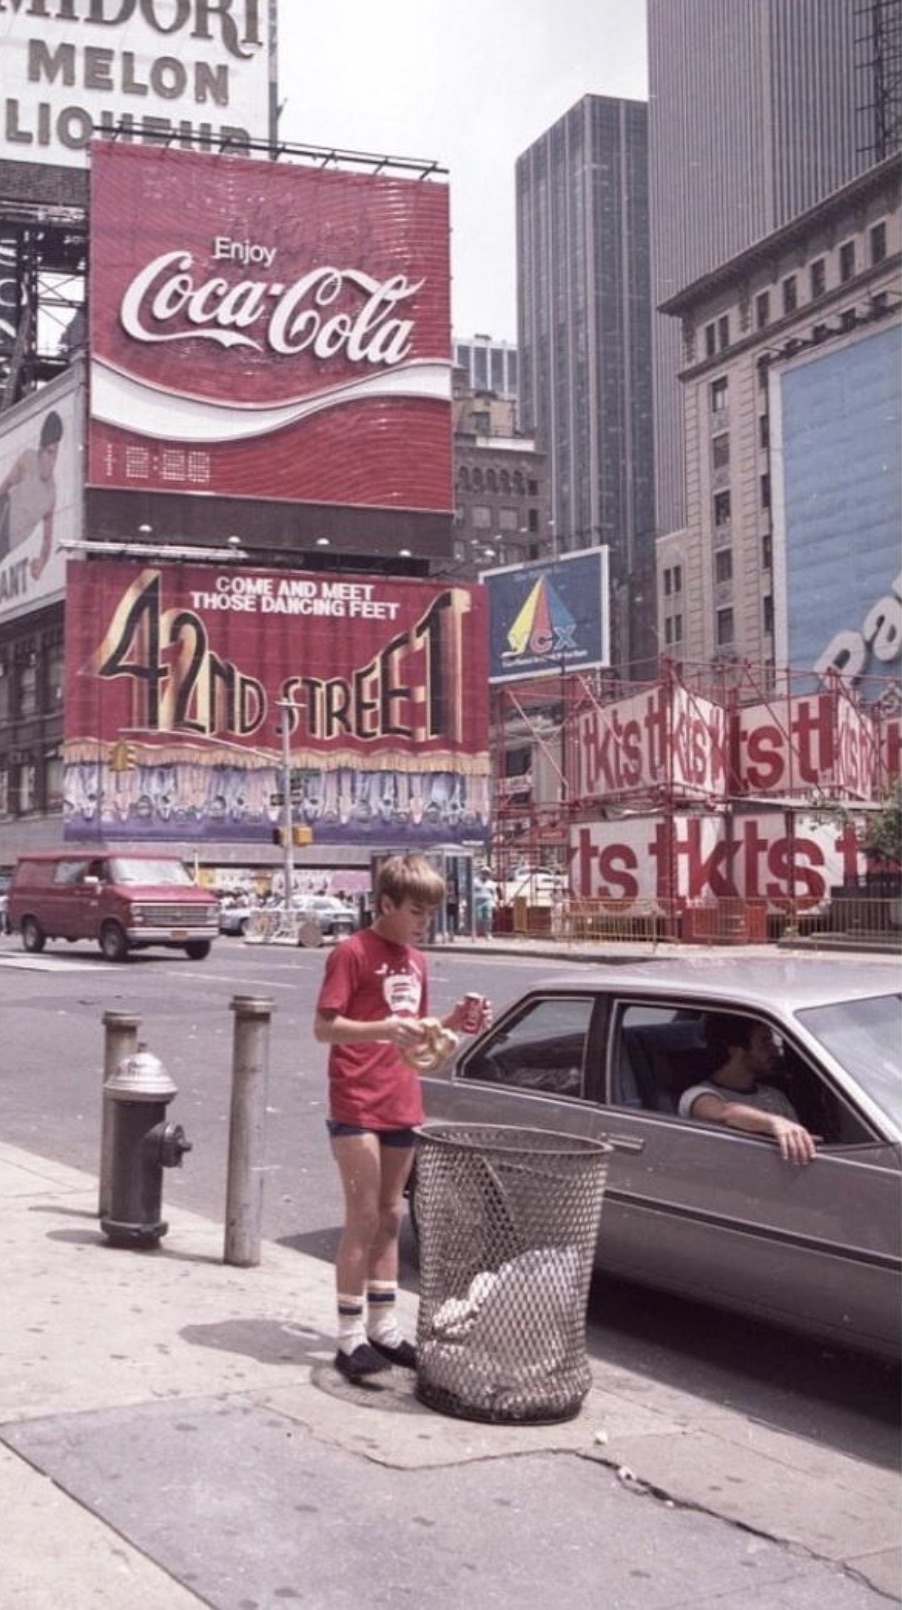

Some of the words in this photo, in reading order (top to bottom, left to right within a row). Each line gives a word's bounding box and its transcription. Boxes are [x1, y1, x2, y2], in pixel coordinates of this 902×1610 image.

[28, 38, 229, 107] MELON
[212, 236, 277, 267] Enjoy
[120, 250, 427, 365] Coca-Cola
[190, 591, 257, 612] THOSE
[261, 595, 346, 617] DANCING
[350, 600, 400, 620] FEET
[215, 576, 274, 596] COME
[277, 579, 317, 599] AND
[321, 582, 375, 600] MEET
[276, 588, 472, 742] STREET
[583, 709, 642, 793] tkts
[648, 818, 826, 912] tkts
